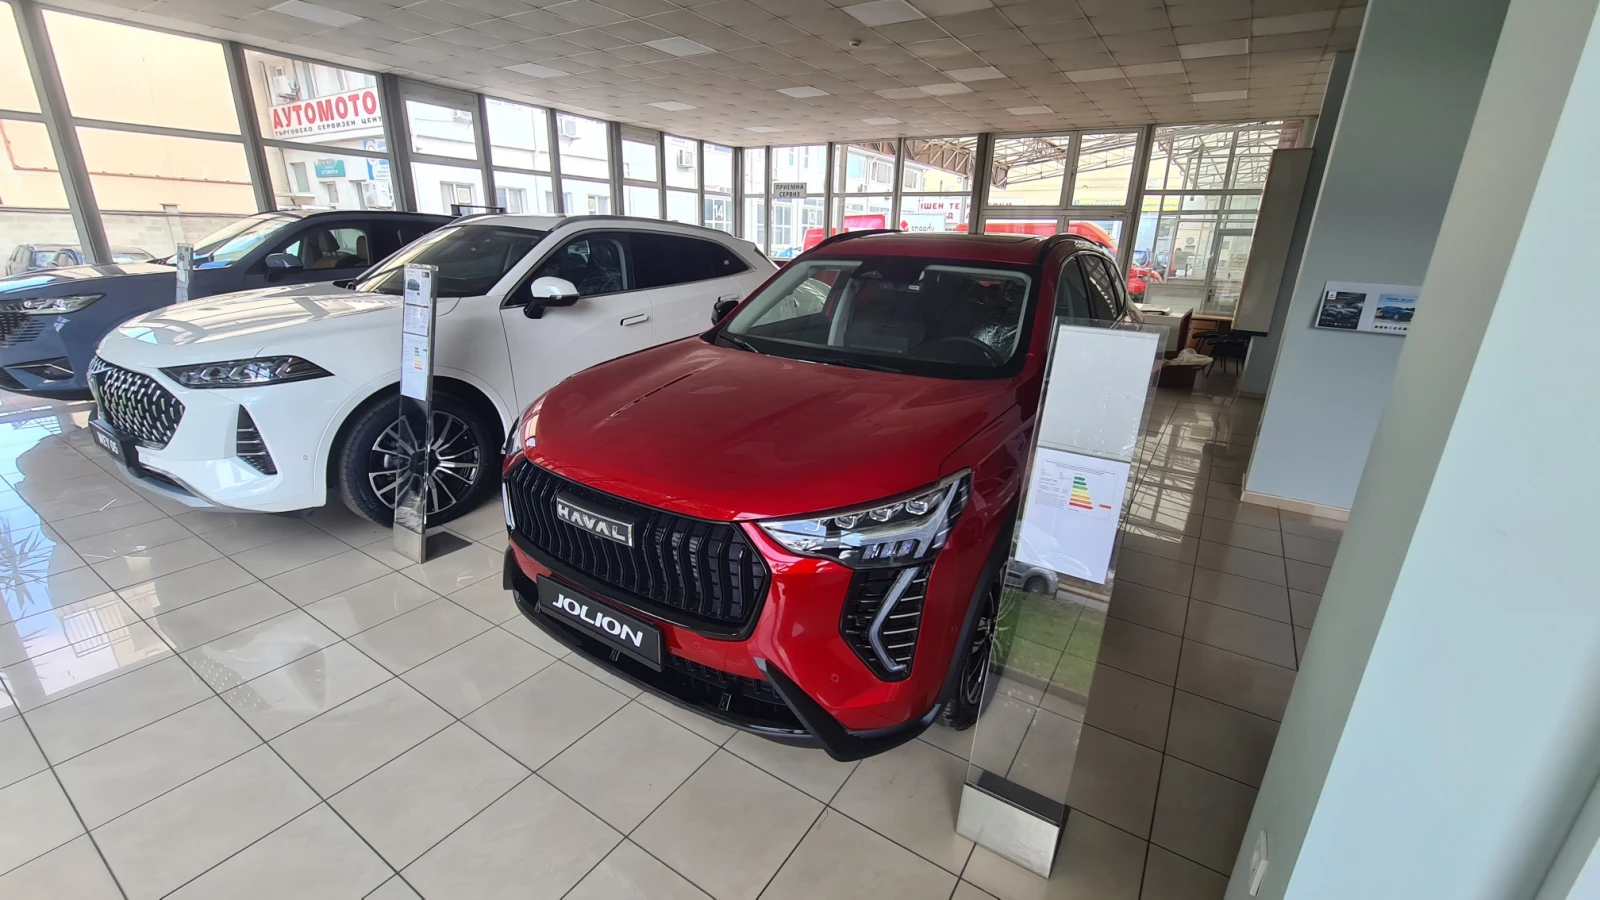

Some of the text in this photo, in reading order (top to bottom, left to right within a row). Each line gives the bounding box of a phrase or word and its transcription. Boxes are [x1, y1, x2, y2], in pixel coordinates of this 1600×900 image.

[273, 91, 376, 129] АУТОМОТО
[275, 126, 313, 136] ТЪРГОВСКО
[317, 120, 356, 131] СЕРВИЗЕН
[714, 204, 724, 218] 14
[557, 503, 626, 541] HAVAL
[552, 593, 644, 647] JOLION
